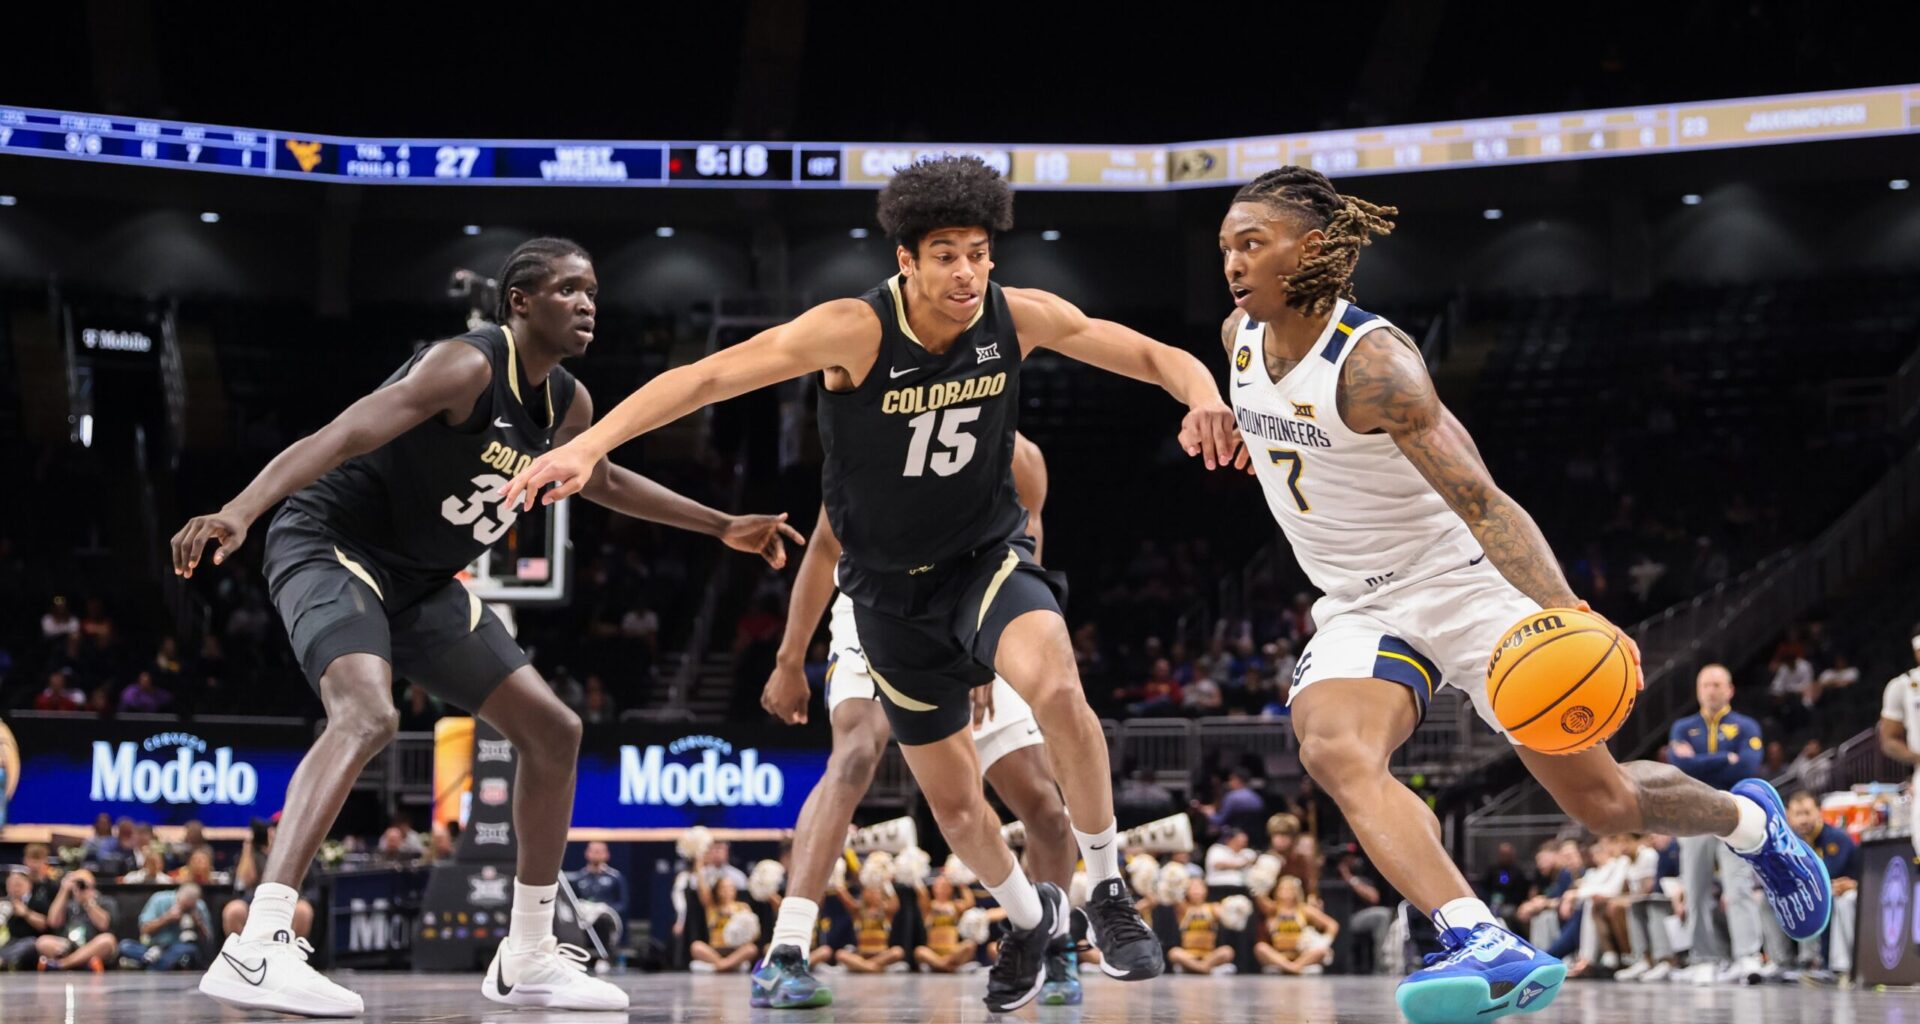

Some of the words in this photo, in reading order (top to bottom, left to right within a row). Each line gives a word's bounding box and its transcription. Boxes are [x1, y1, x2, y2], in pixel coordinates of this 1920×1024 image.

[435, 145, 480, 178] 27
[697, 144, 768, 177] 5:18
[882, 371, 1006, 414] COLORADO
[902, 406, 982, 477] 15
[1235, 404, 1332, 448] MOUNTAINEERS
[480, 441, 535, 477] COLO
[1268, 449, 1310, 512] 7
[1487, 614, 1566, 679] Wilson
[90, 740, 258, 805] Modelo
[619, 745, 784, 807] Modelo
